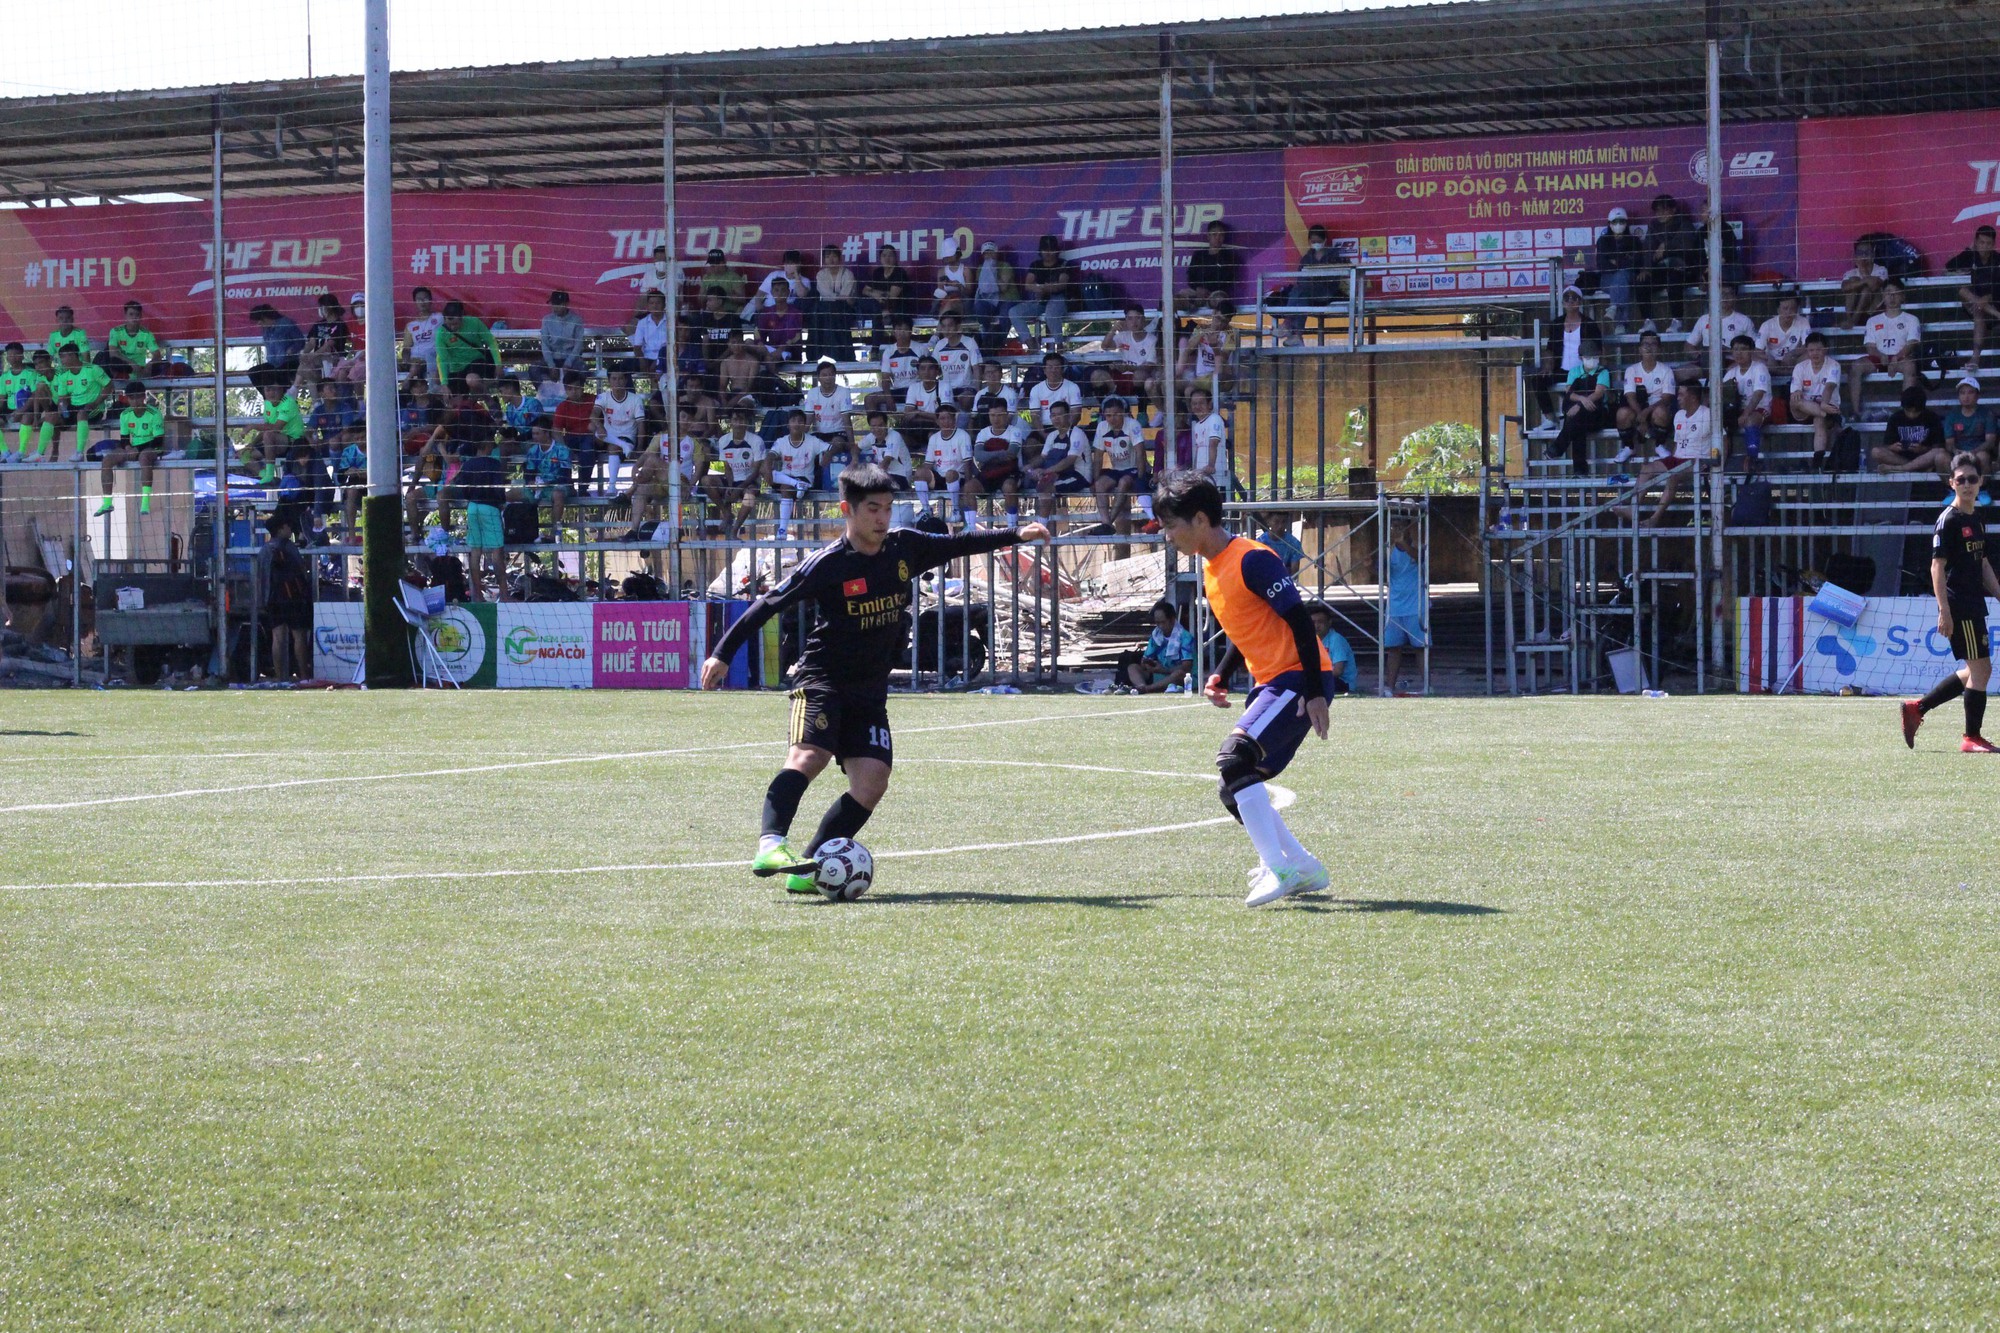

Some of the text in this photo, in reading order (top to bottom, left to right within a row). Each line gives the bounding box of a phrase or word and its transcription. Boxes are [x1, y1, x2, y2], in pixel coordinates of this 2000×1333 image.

[1396, 142, 1659, 173] GIẢI BÓNG ĐÁ VÔ ĐỊCH THANH HOÁ MIỀN NAM
[1395, 166, 1659, 198] CUP ĐÔNG Á THANH HOÁ
[1057, 202, 1225, 241] THF CUP
[1469, 197, 1492, 218] LẦN
[1497, 202, 1511, 217] 10
[1522, 199, 1549, 216] NĂM
[1552, 198, 1584, 215] 2023
[200, 238, 342, 272] THF CUP
[685, 225, 762, 256] CUP
[842, 227, 975, 263] #THF10
[24, 256, 137, 289] #THF10
[411, 243, 532, 276] #THF10
[1080, 259, 1120, 271] DONG
[1121, 258, 1132, 269] A
[254, 288, 263, 297] A
[265, 286, 302, 296] THANH
[304, 286, 329, 295] HOA
[1266, 576, 1293, 598] GOAT
[601, 618, 681, 642] HOA TƯƠI
[601, 645, 681, 673] HUẾ KEM
[869, 725, 891, 750] 18
